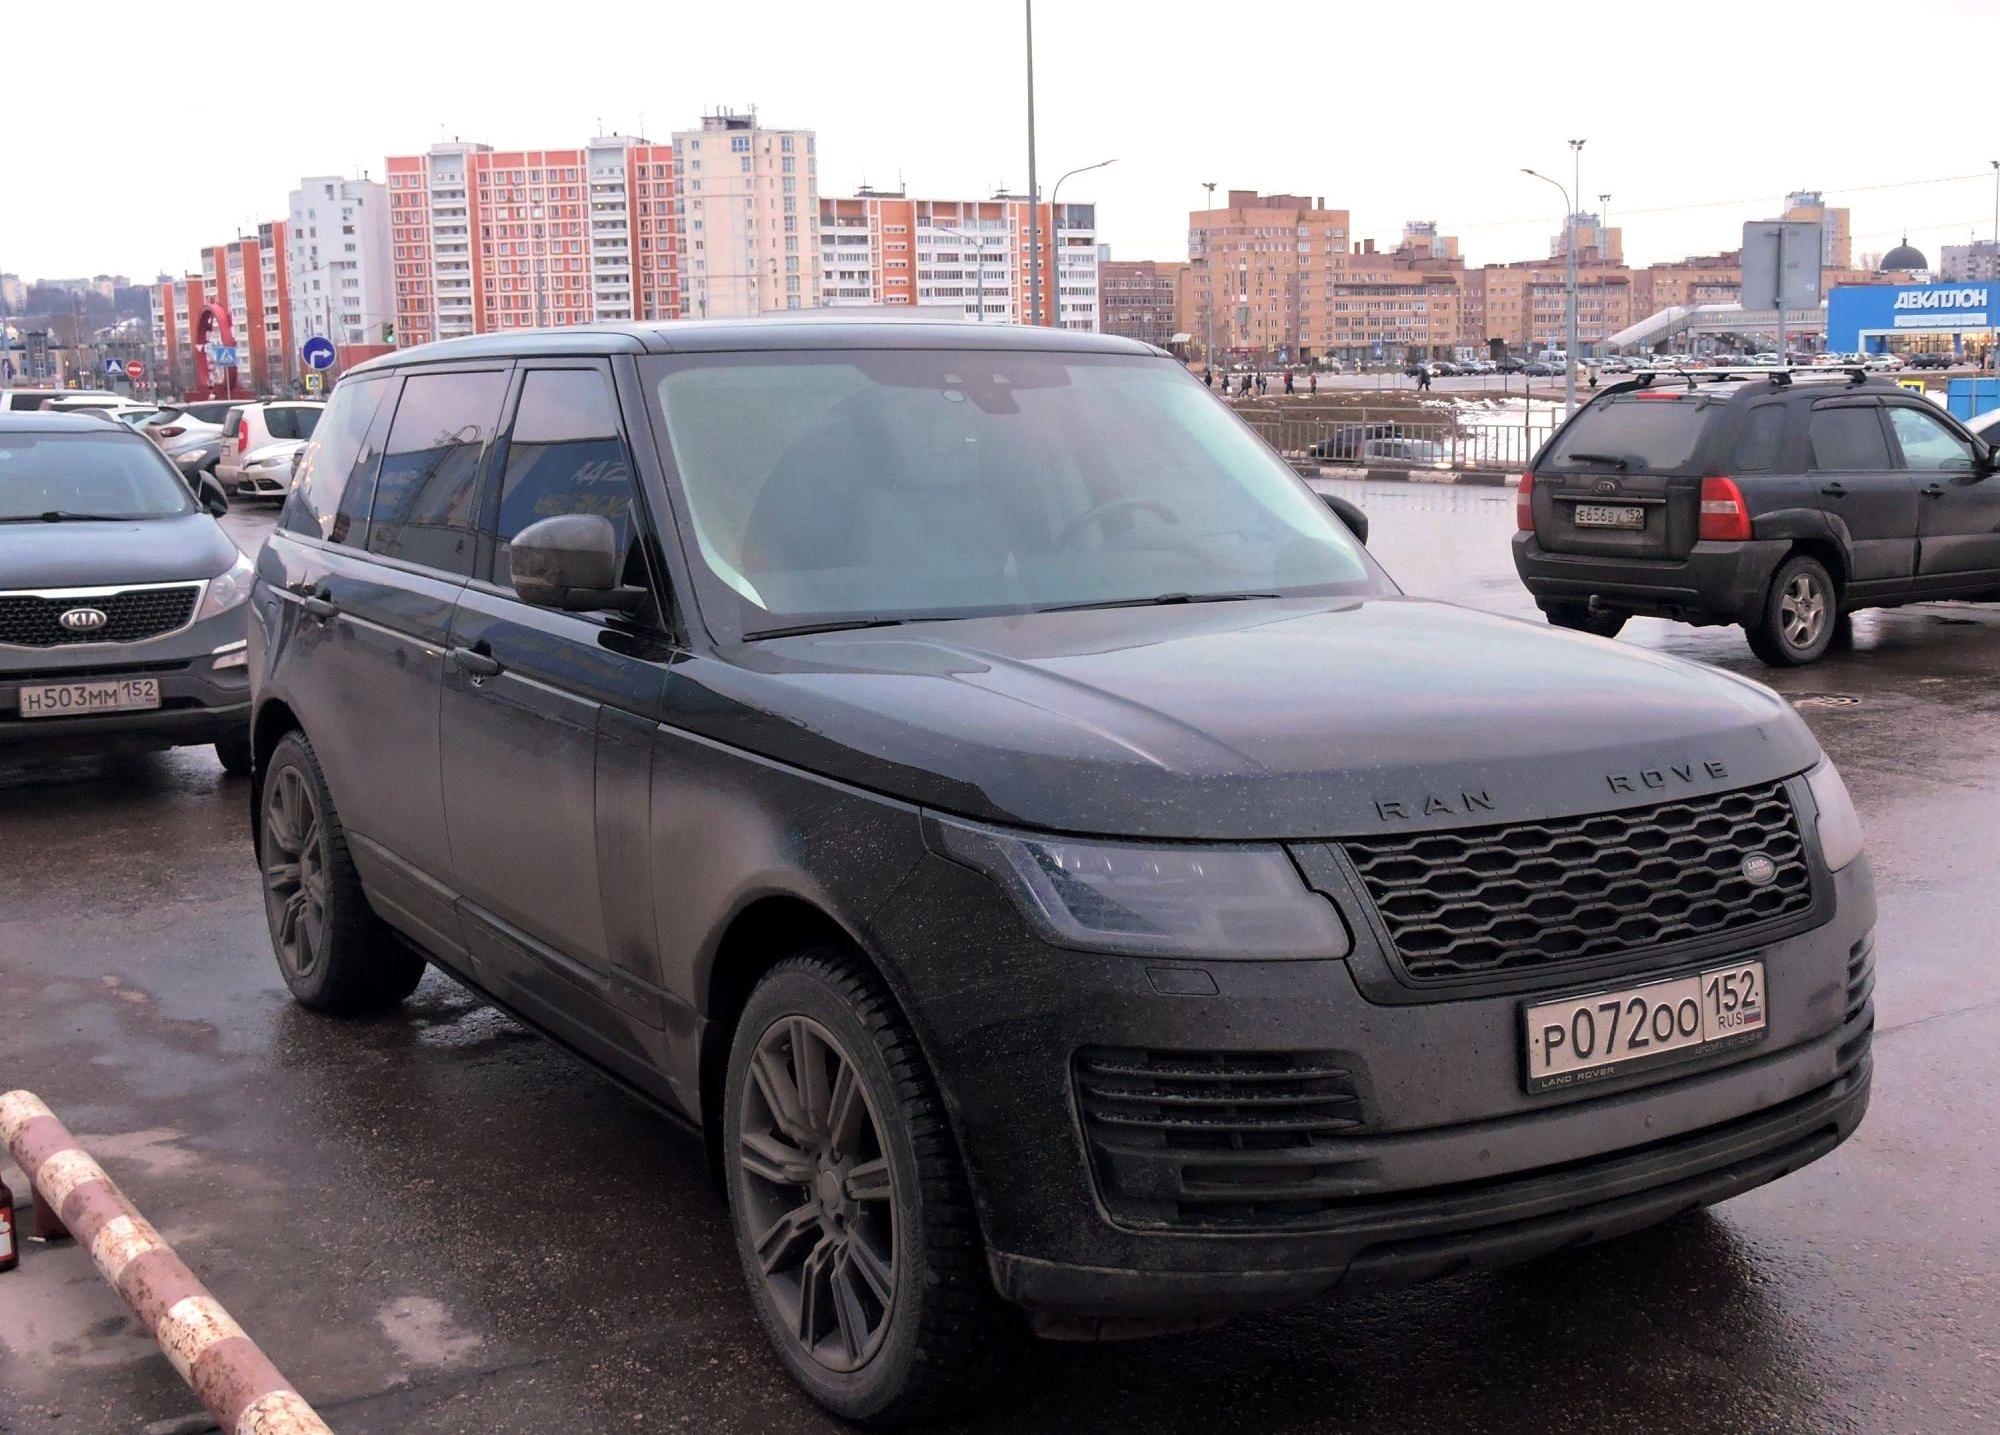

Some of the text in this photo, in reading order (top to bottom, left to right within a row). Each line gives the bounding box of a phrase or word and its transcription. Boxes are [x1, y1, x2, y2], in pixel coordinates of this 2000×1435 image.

[1894, 288, 1988, 309] ДЕКАТЛОН
[1625, 508, 1641, 521] 152
[68, 613, 100, 627] KIA
[122, 681, 154, 698] 152
[1705, 969, 1756, 1016] 152
[1718, 1012, 1743, 1030] RUS
[1541, 1067, 1616, 1088] LAND ROVER
